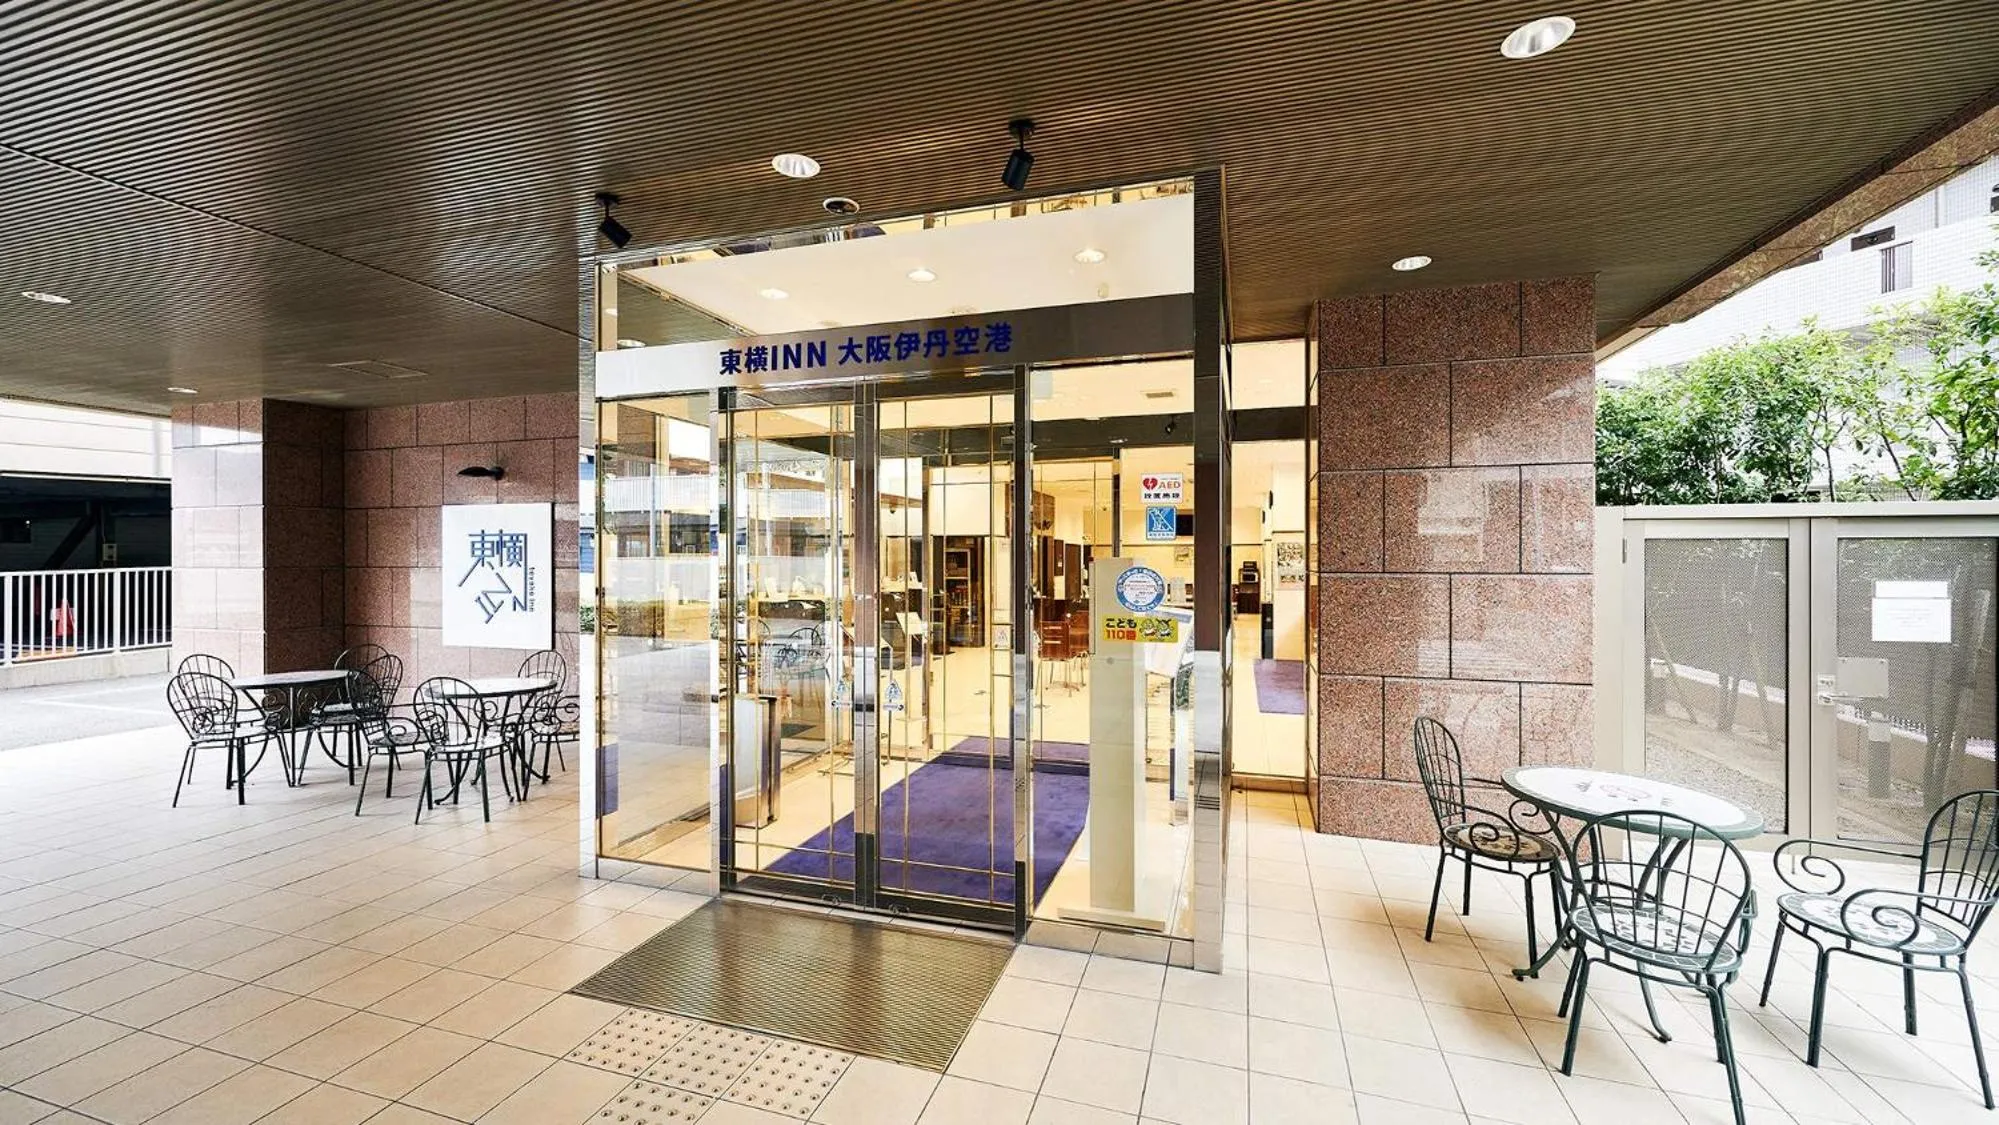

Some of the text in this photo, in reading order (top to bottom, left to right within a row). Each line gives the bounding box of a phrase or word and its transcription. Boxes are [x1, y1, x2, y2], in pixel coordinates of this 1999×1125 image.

[719, 321, 1013, 375] 東横INN 大阪伊丹空港
[1158, 480, 1181, 489] AED
[1105, 617, 1138, 629] こども
